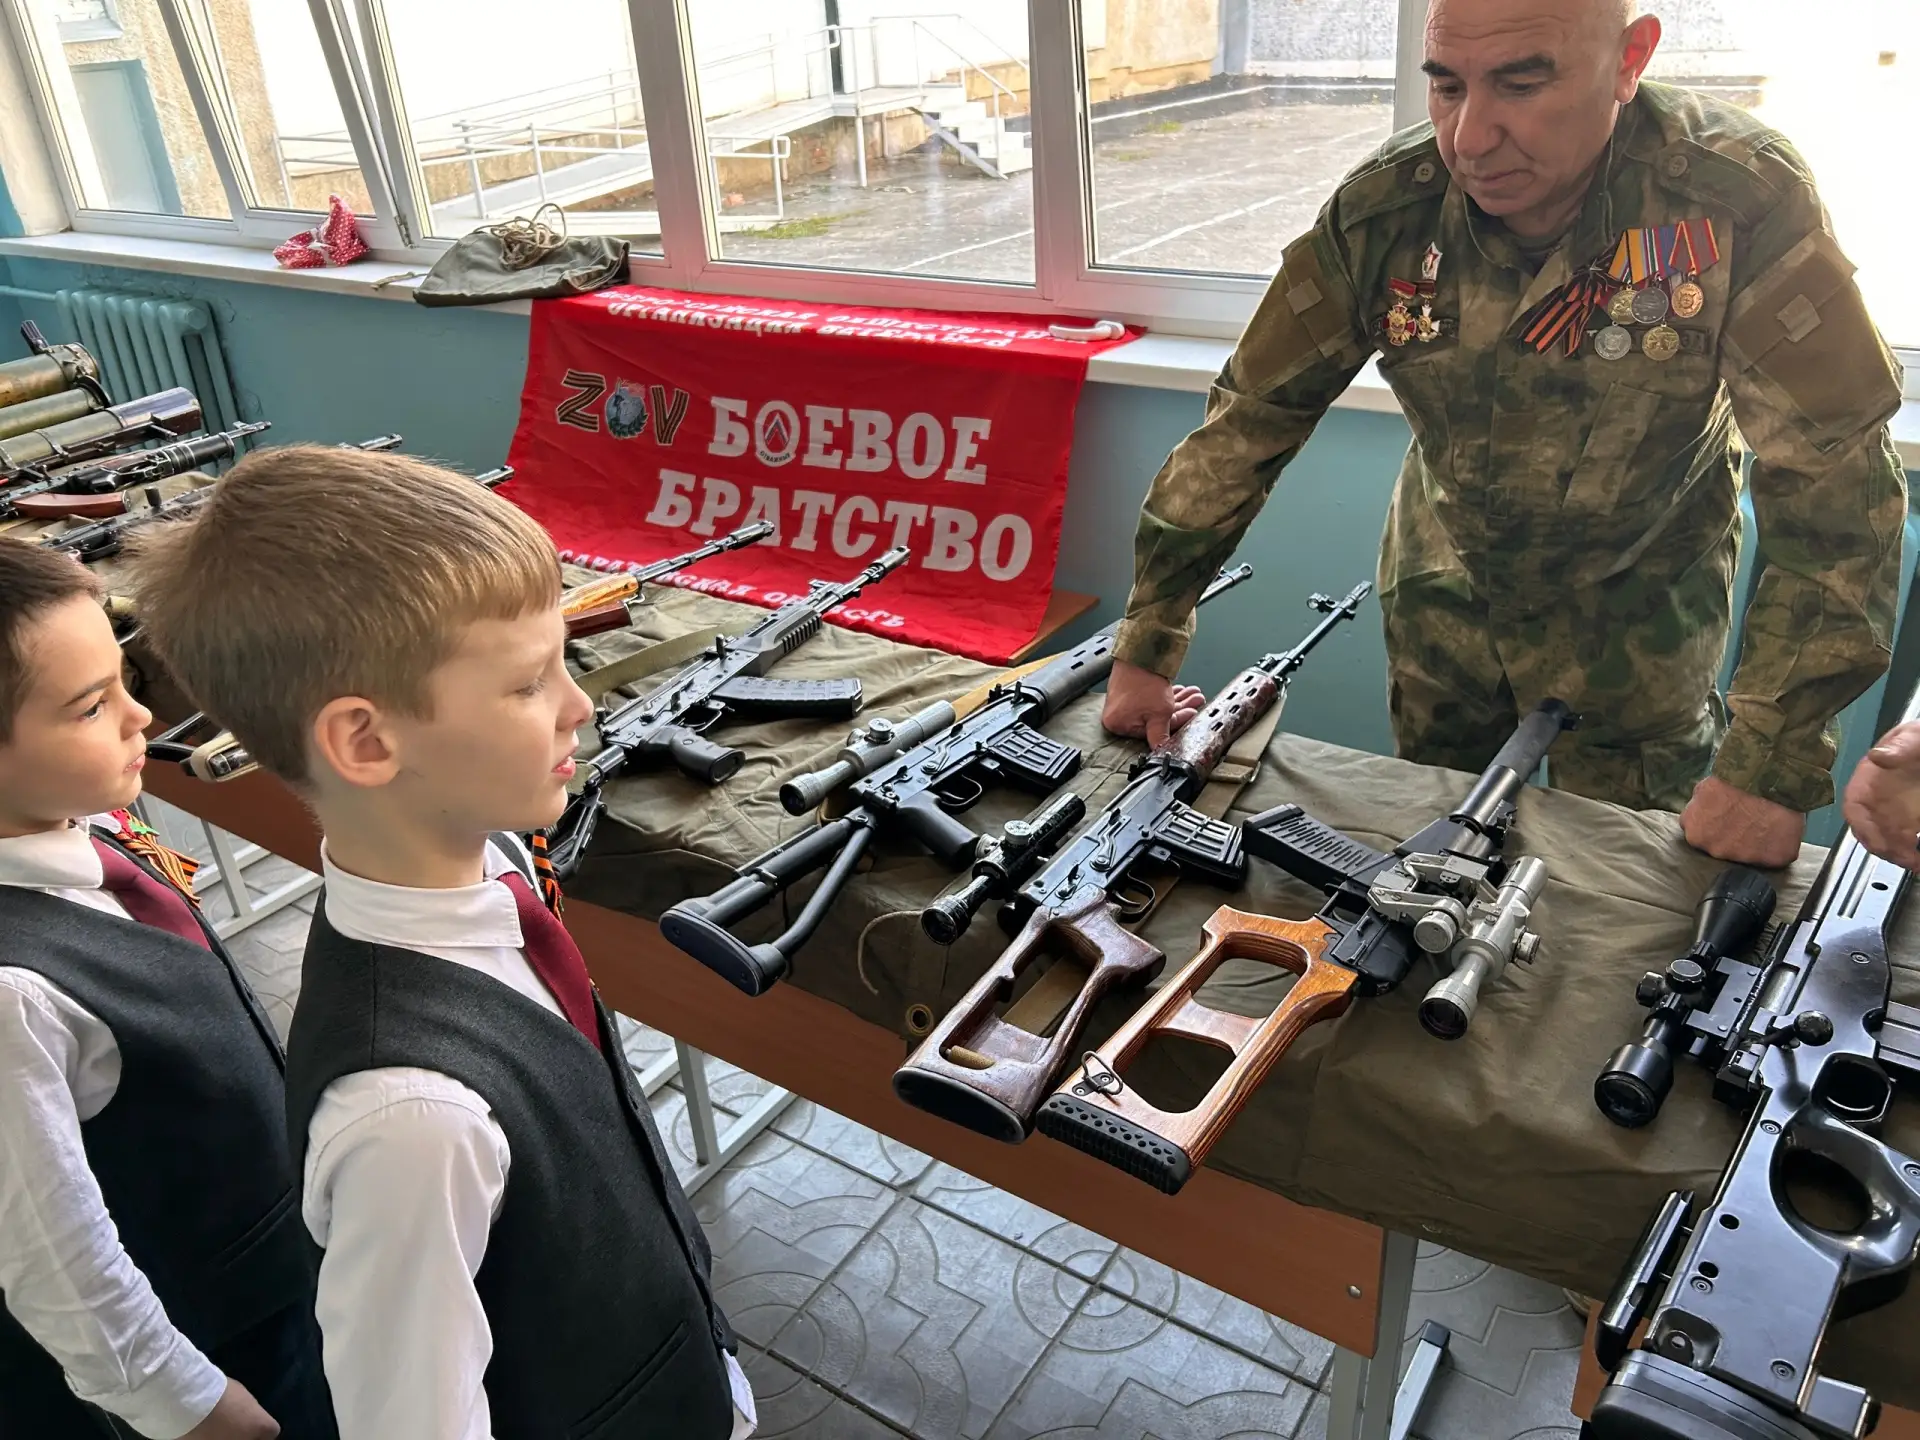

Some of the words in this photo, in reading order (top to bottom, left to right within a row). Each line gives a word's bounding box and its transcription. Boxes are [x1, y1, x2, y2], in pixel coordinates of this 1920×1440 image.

[708, 396, 992, 485] БОЕВОЕ
[645, 468, 1033, 582] БРАТСТВО
[559, 549, 757, 596] САРАТВСКАЯ
[763, 591, 905, 628] ОБСТЬ
